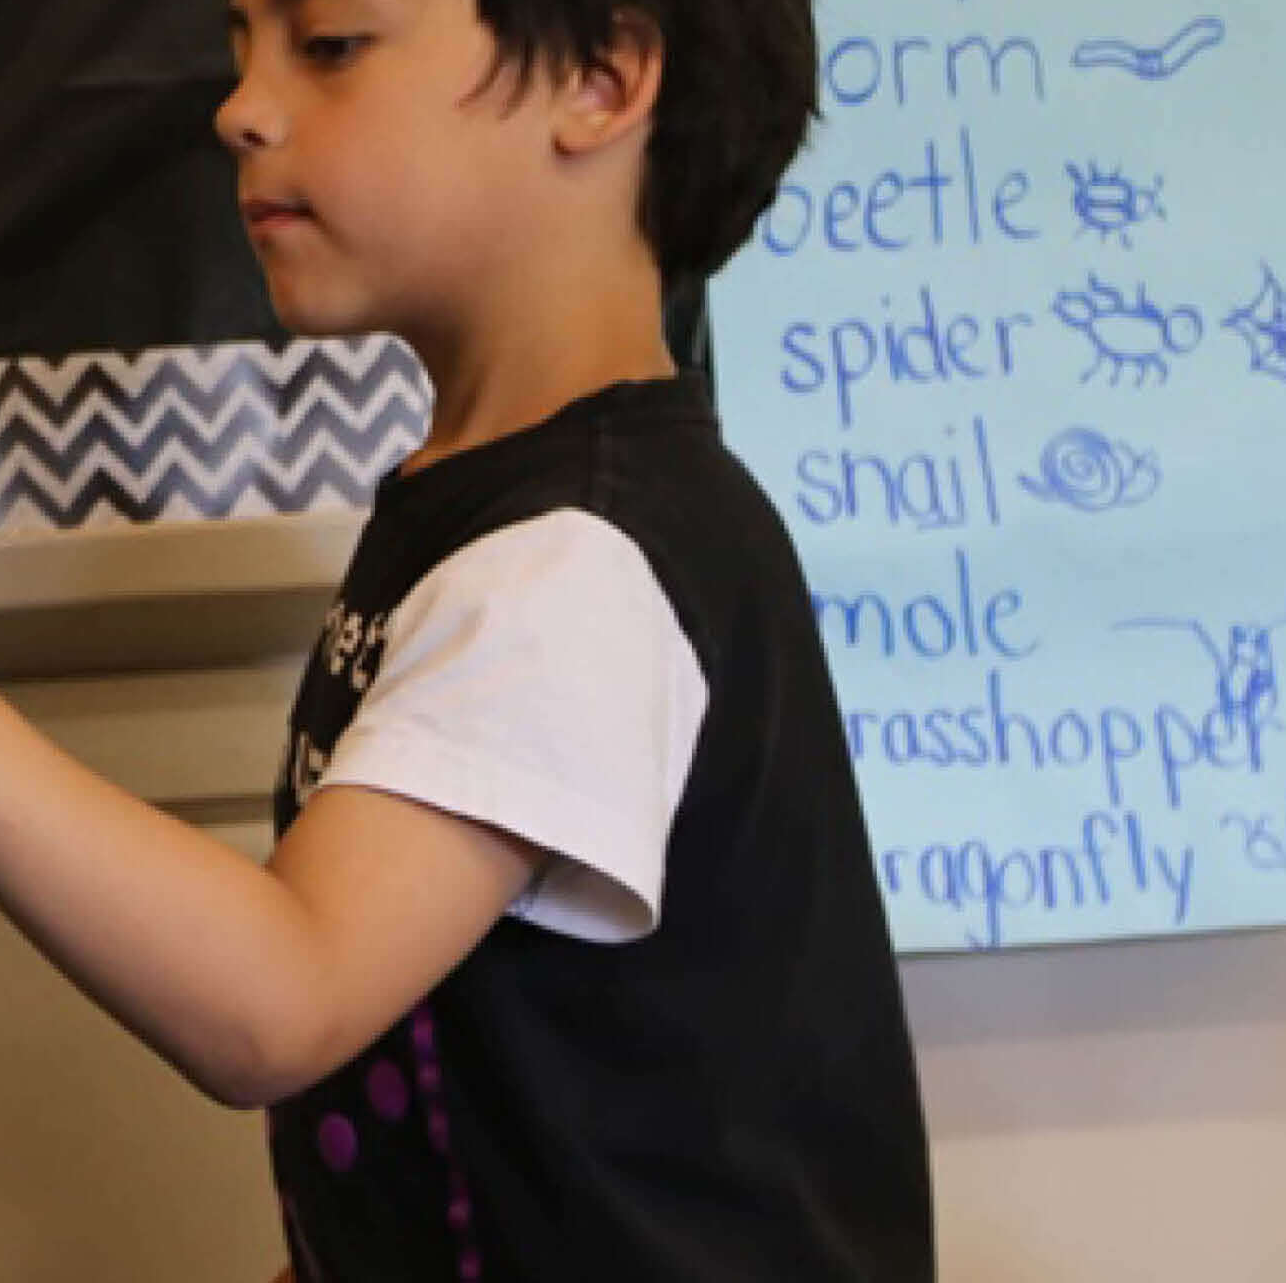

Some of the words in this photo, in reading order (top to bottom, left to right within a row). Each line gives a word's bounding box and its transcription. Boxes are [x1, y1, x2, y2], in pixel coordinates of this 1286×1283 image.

[825, 35, 1045, 107] orm
[780, 284, 1035, 430] spider
[795, 416, 1000, 532] snail
[809, 547, 1044, 662] mole
[849, 667, 1282, 810] rasshopper
[882, 809, 1195, 952] ragonfly
